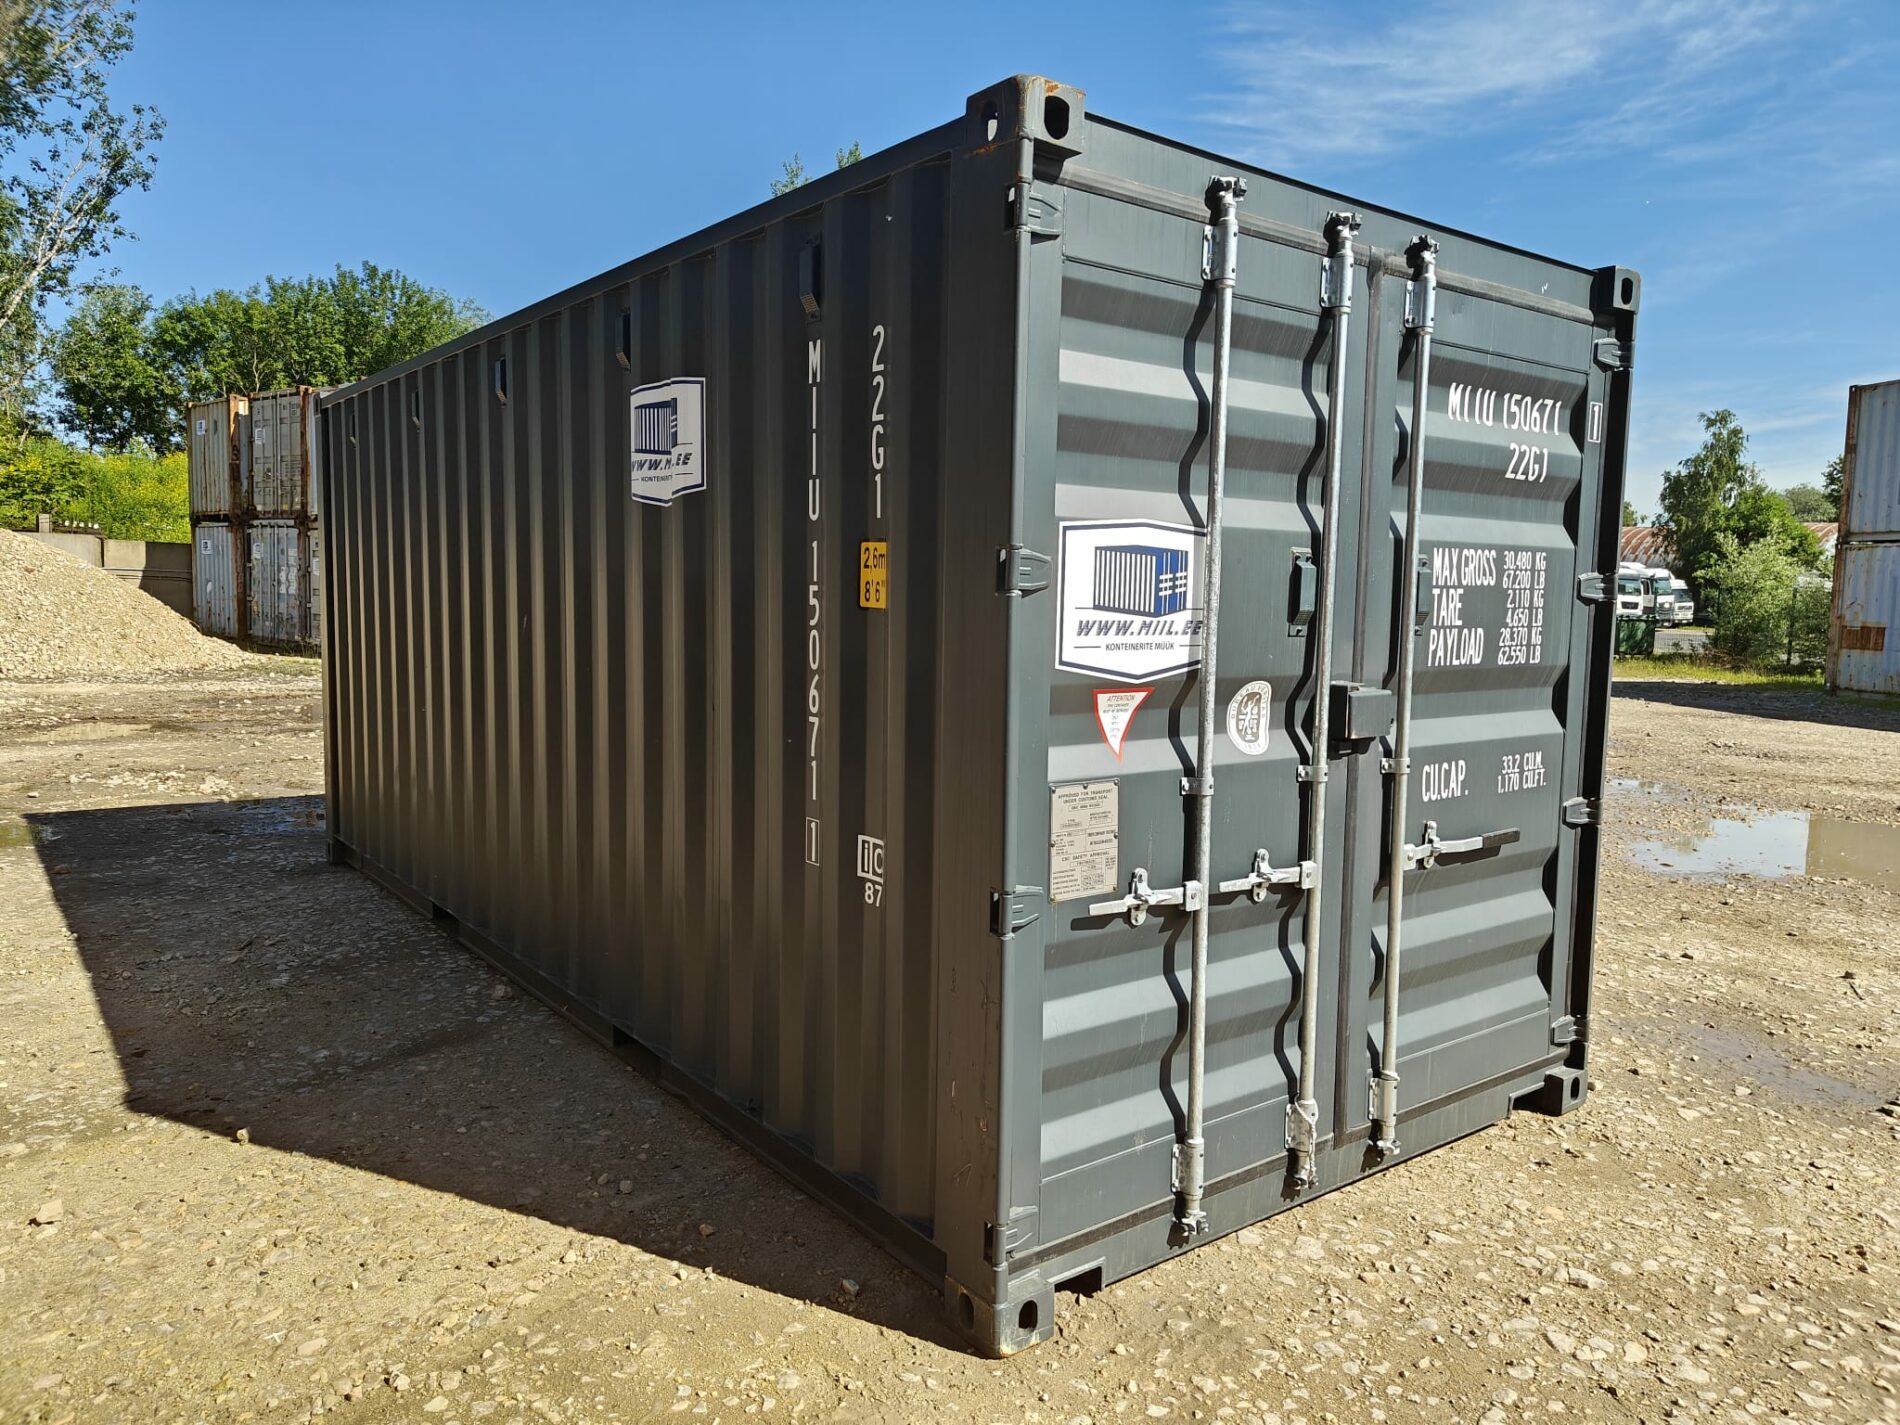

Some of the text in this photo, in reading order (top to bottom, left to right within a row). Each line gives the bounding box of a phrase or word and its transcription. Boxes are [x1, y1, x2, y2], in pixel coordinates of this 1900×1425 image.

[871, 324, 885, 519] 22G1
[1448, 382, 1562, 436] MIIU 150671
[808, 338, 821, 522] MIIU
[1504, 442, 1548, 483] 22G1
[1432, 547, 1547, 587] MAX GROSS 30.480 KG
[1502, 570, 1546, 589] 67.200 LB
[1432, 588, 1544, 626] TARE 2.110 KG
[1532, 608, 1543, 627] LB
[1076, 620, 1203, 637] WWW.MIIL.EE
[1105, 641, 1175, 652] KONTEINERITE MÜÜK
[1427, 627, 1542, 667] PAYLOAD 28.370 KG
[808, 540, 820, 801] 150671
[1529, 645, 1541, 664] LB
[1501, 754, 1520, 774] 33.2
[864, 881, 882, 908] 87
